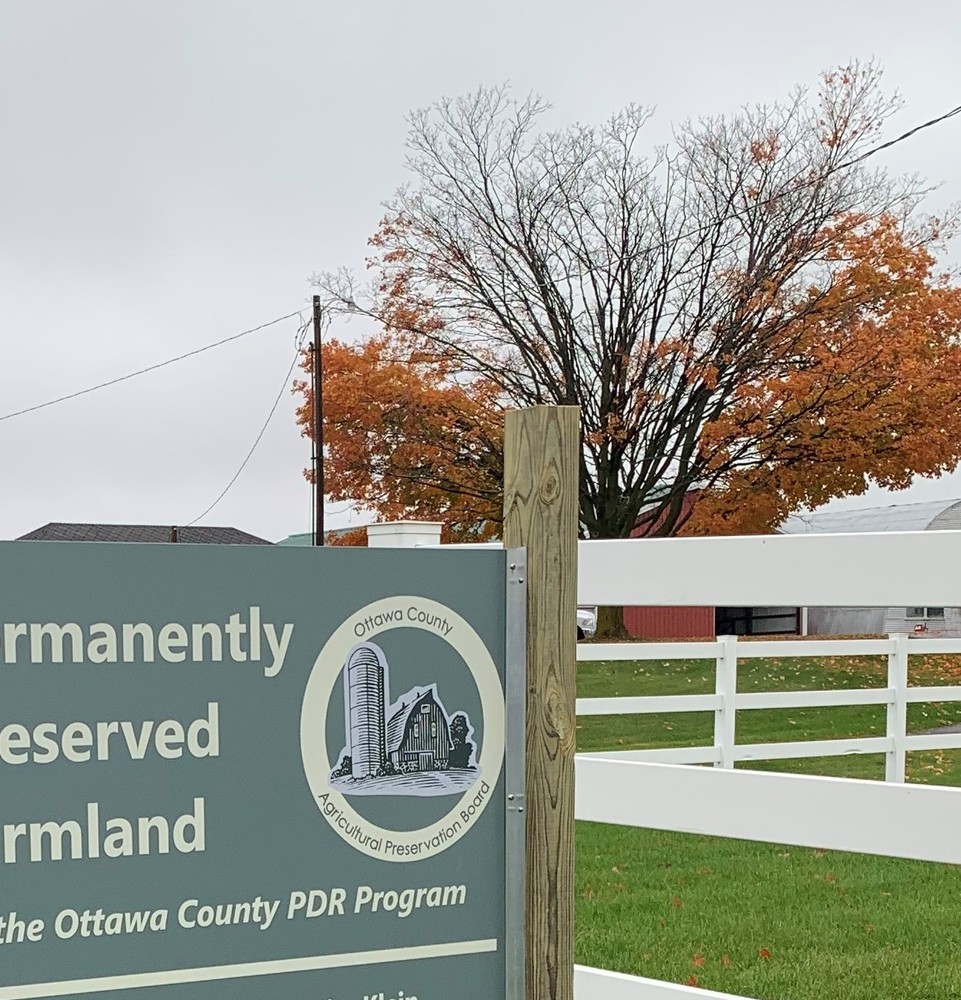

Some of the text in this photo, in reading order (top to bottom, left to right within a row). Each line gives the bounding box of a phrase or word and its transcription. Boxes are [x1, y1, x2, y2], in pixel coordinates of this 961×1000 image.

[354, 606, 454, 638] Ottawa County
[318, 780, 490, 856] Agricultural Preservation Board
[53, 904, 168, 938] Ottawa
[177, 896, 280, 933] County
[286, 888, 346, 920] PDR
[354, 884, 467, 918] Program
